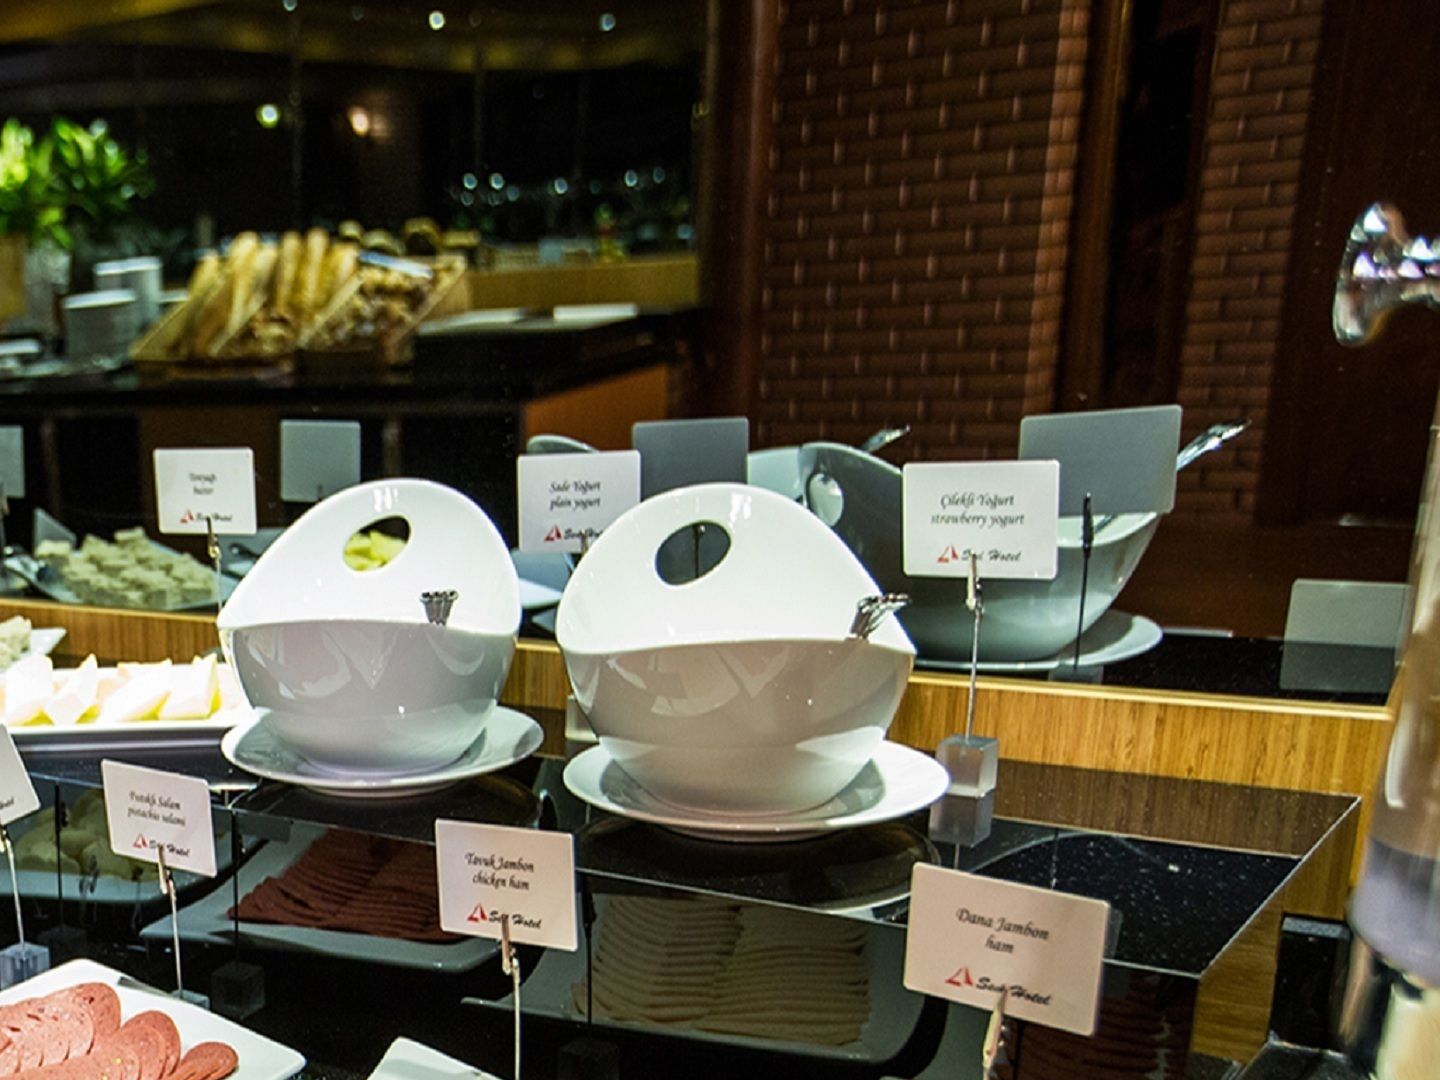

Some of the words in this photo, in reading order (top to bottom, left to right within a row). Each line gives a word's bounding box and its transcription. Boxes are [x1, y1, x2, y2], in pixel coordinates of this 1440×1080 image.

[931, 511, 987, 529] strawberry
[988, 514, 1025, 529] yogurt
[988, 549, 1022, 562] Hotel
[464, 851, 496, 867] Tavuk
[493, 855, 535, 872] Jambon
[472, 870, 507, 889] chicken
[509, 875, 530, 891] ham
[512, 913, 543, 929] Hotel
[956, 907, 993, 928] Dana
[995, 916, 1050, 940] Jambon
[985, 934, 1015, 954] ham
[1010, 984, 1052, 1006] Hotel
